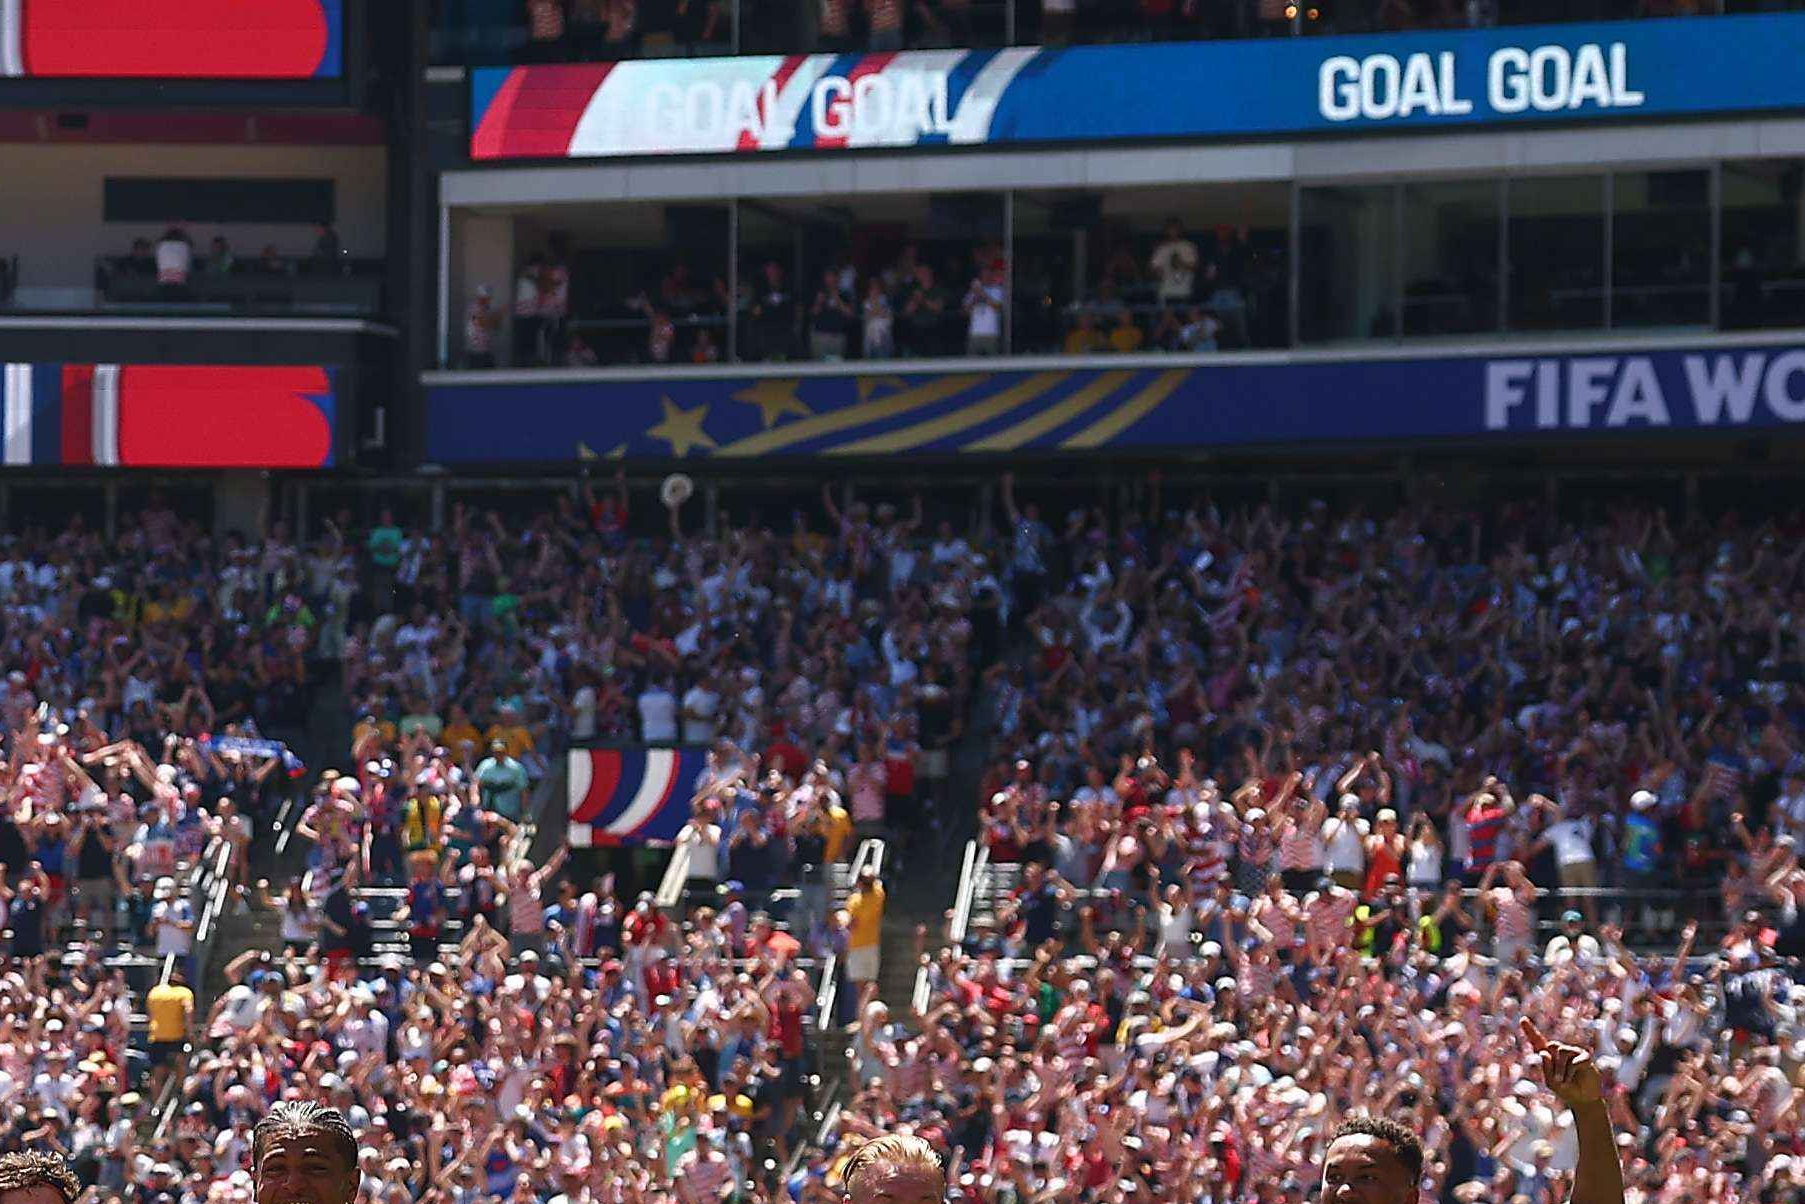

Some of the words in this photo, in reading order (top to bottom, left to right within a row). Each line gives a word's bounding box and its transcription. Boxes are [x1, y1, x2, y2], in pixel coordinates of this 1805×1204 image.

[812, 70, 969, 138] GOAL
[1319, 50, 1474, 121] GOAL
[1487, 42, 1645, 113] GOAL
[1485, 355, 1672, 431] FIFA
